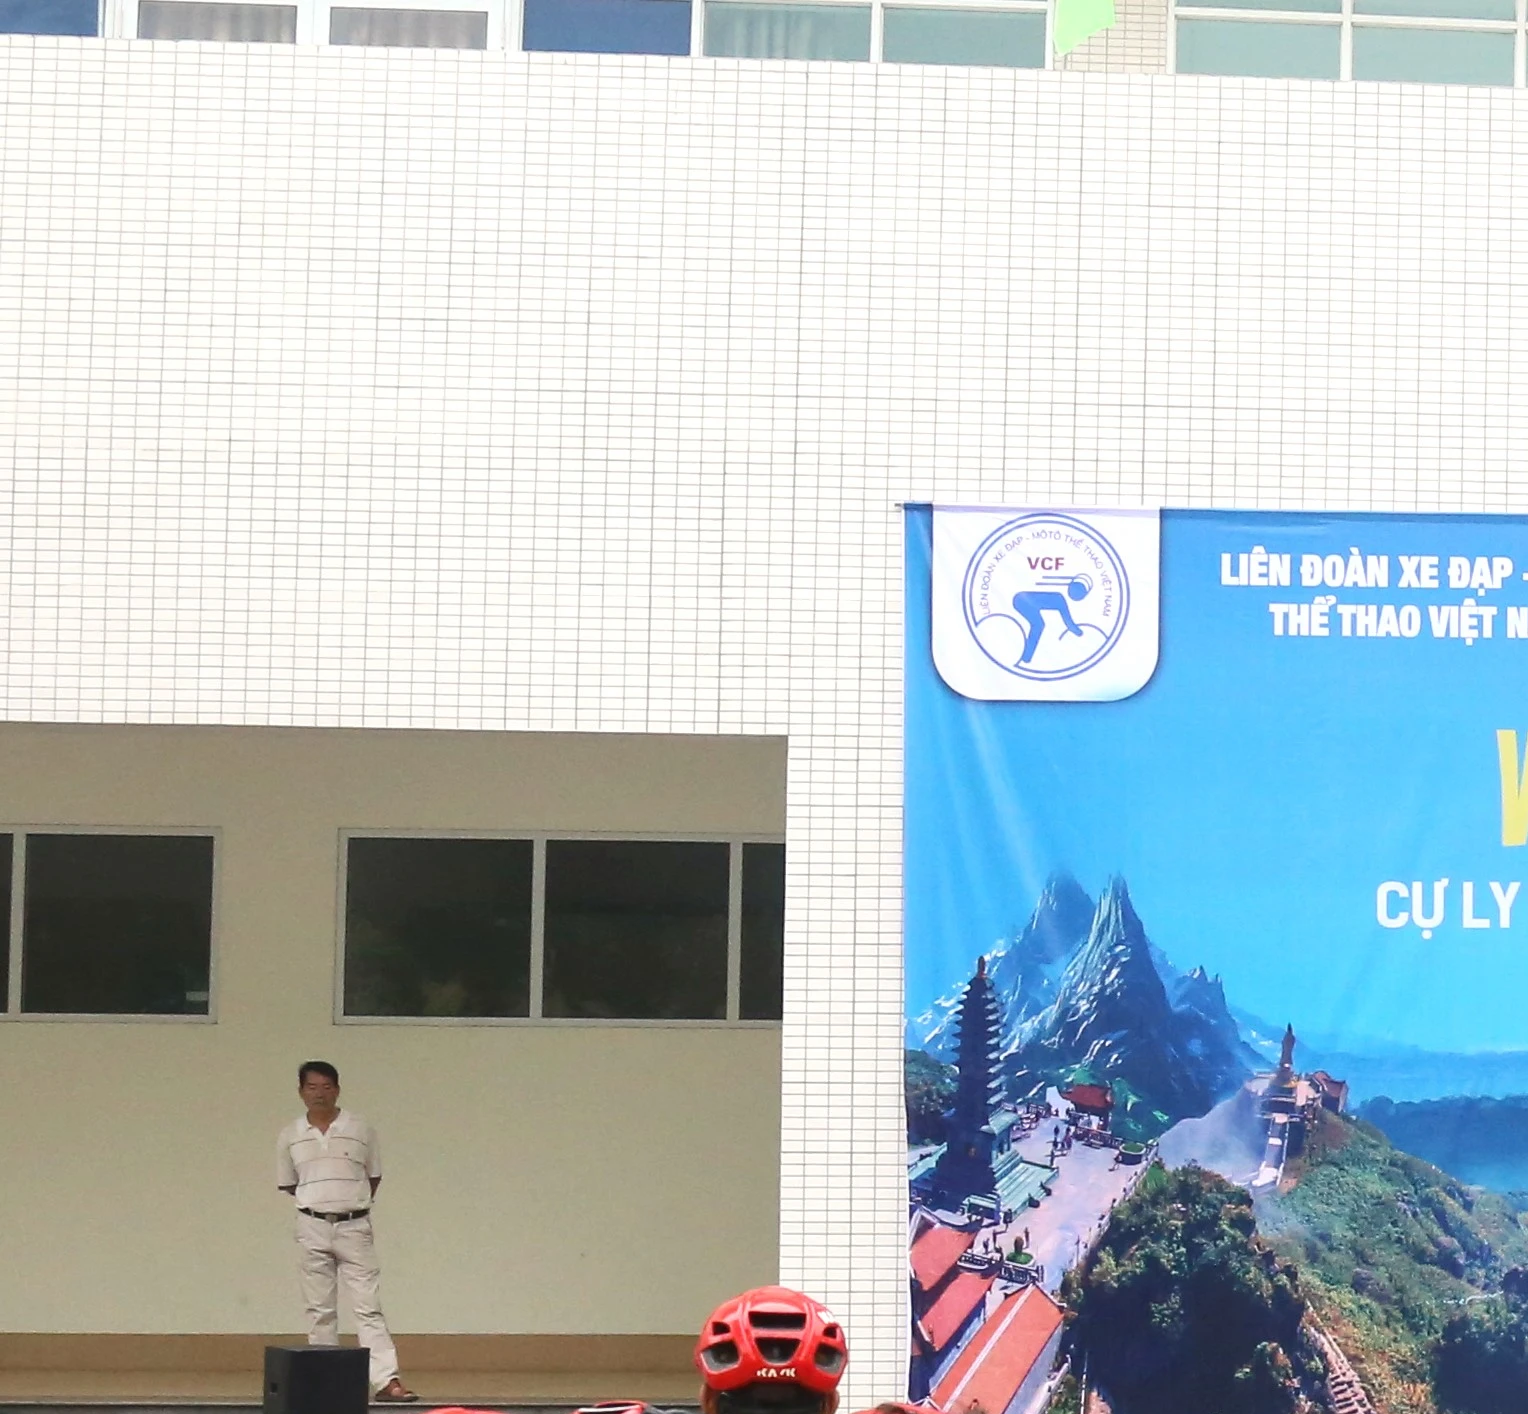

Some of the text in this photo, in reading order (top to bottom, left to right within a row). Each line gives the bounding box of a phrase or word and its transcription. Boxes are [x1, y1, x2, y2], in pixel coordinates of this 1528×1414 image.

[1027, 556, 1065, 571] VCF
[1220, 545, 1291, 587] LIÊN
[1300, 547, 1389, 588] ĐOÀN
[1398, 555, 1439, 588] XE
[1447, 556, 1513, 597] ĐẠP
[1269, 595, 1337, 637] THỂ
[1337, 604, 1421, 639] THAO
[1429, 598, 1497, 646] VIỆT
[1375, 877, 1449, 939] CỰ
[1462, 881, 1520, 929] LY
